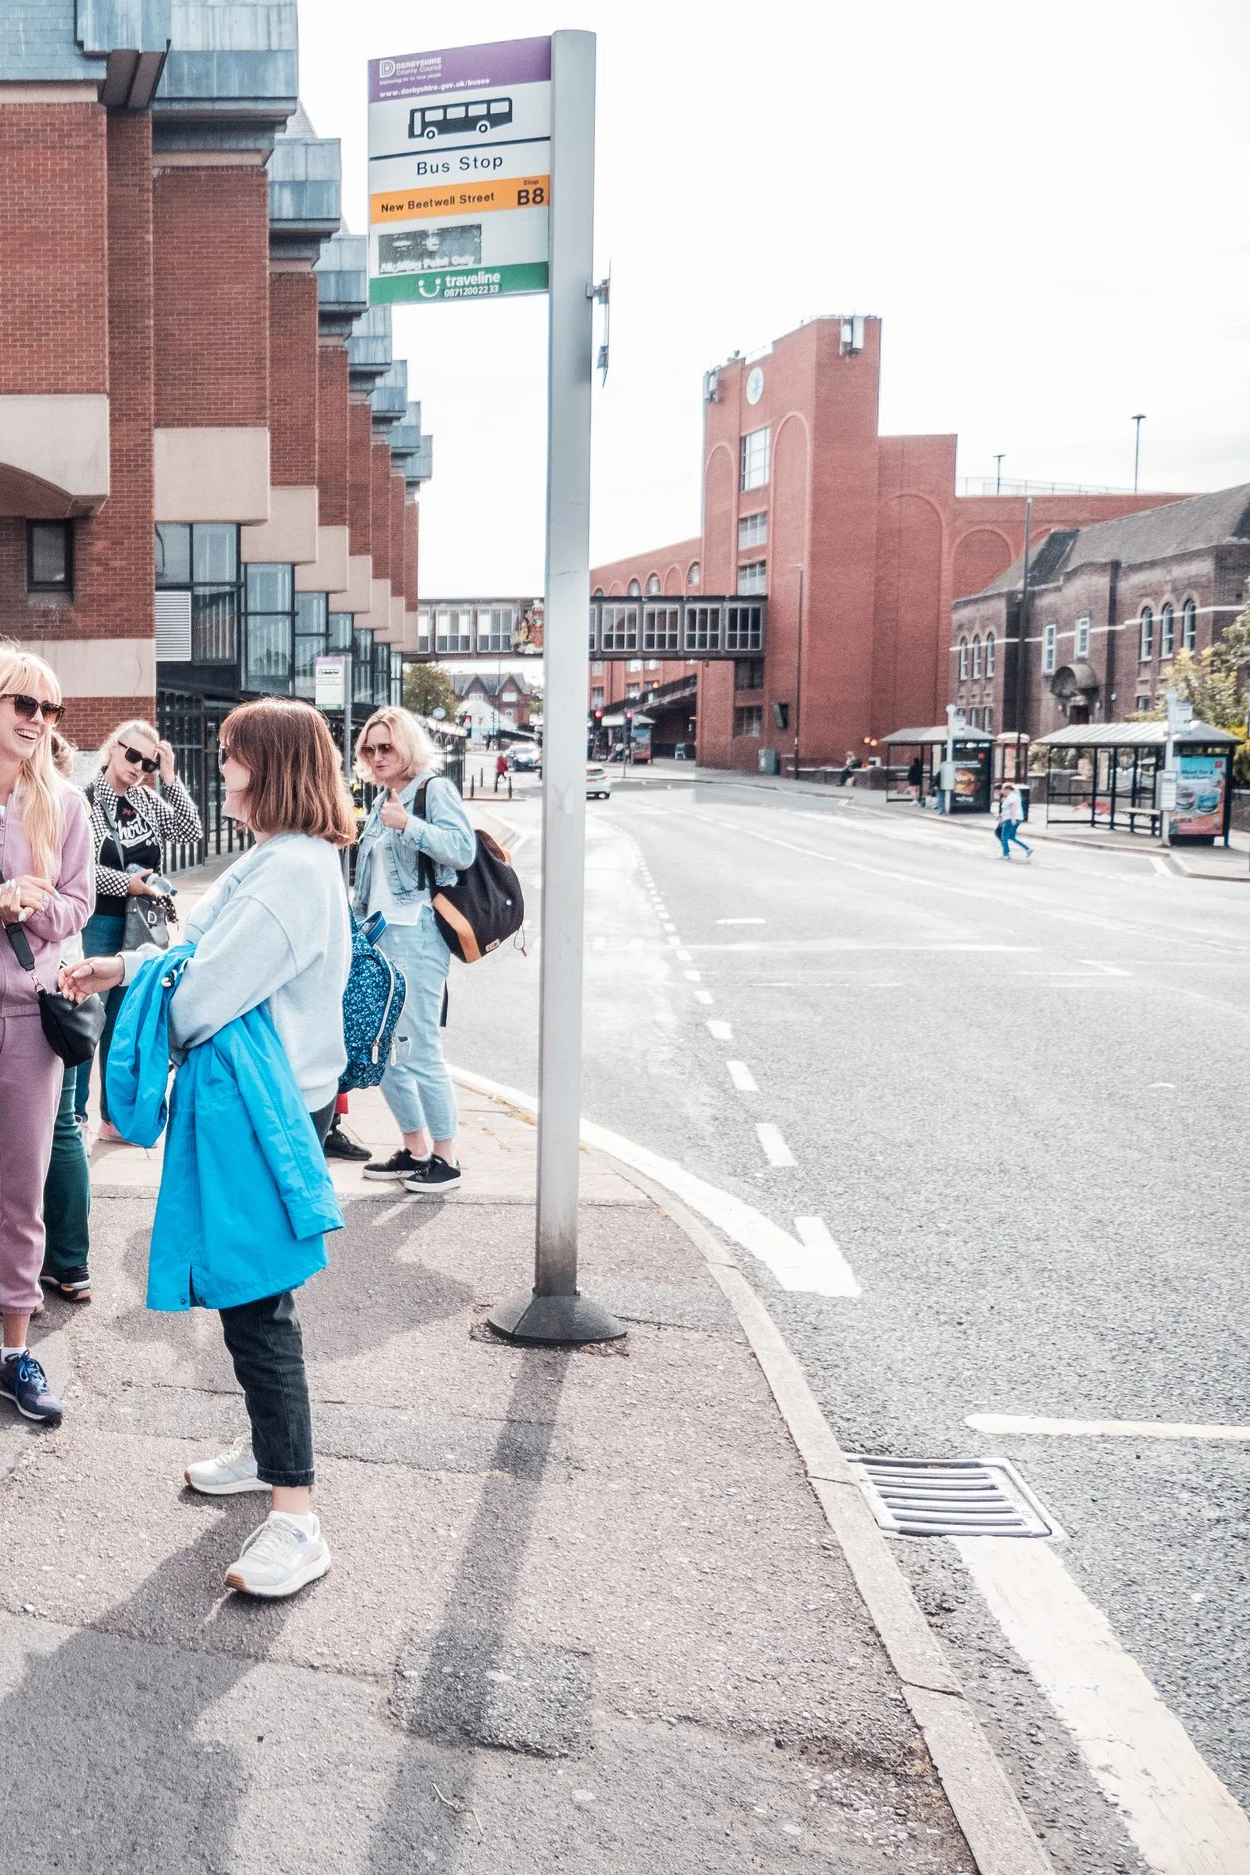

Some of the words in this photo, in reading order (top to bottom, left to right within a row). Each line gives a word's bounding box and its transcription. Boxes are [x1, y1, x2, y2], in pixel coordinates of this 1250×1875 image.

[396, 56, 442, 70] DERBYSHIRE
[396, 67, 418, 77] County
[419, 64, 442, 74] Council
[379, 78, 490, 98] www.derbyshire.gov.uk/buses
[416, 161, 450, 176] Bus
[459, 156, 503, 170] Stop
[381, 203, 404, 213] New
[407, 196, 456, 210] Beetwell
[459, 192, 495, 204] Street
[517, 187, 545, 206] B8
[445, 271, 501, 288] traveline
